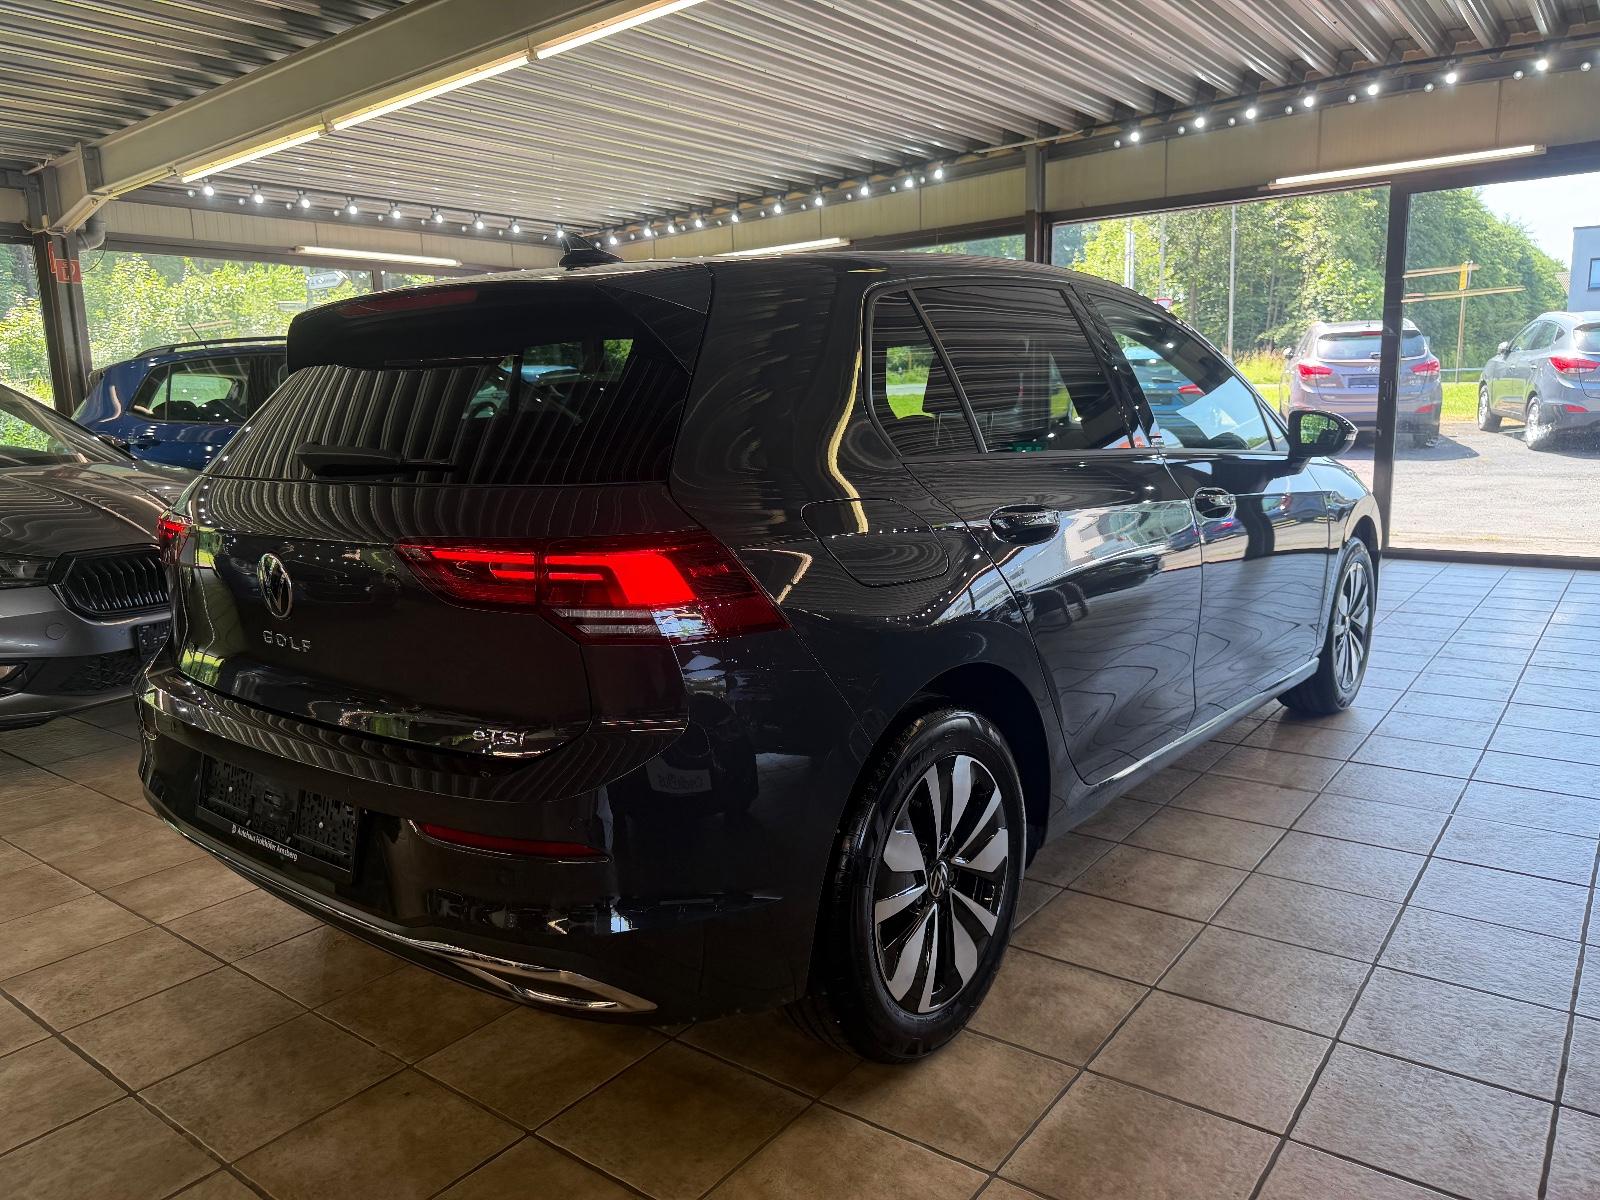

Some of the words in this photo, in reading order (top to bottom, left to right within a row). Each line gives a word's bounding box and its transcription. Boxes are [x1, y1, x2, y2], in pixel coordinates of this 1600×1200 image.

[262, 630, 311, 652] GOLF
[472, 728, 526, 746] eTSI
[237, 827, 255, 842] Autohaus
